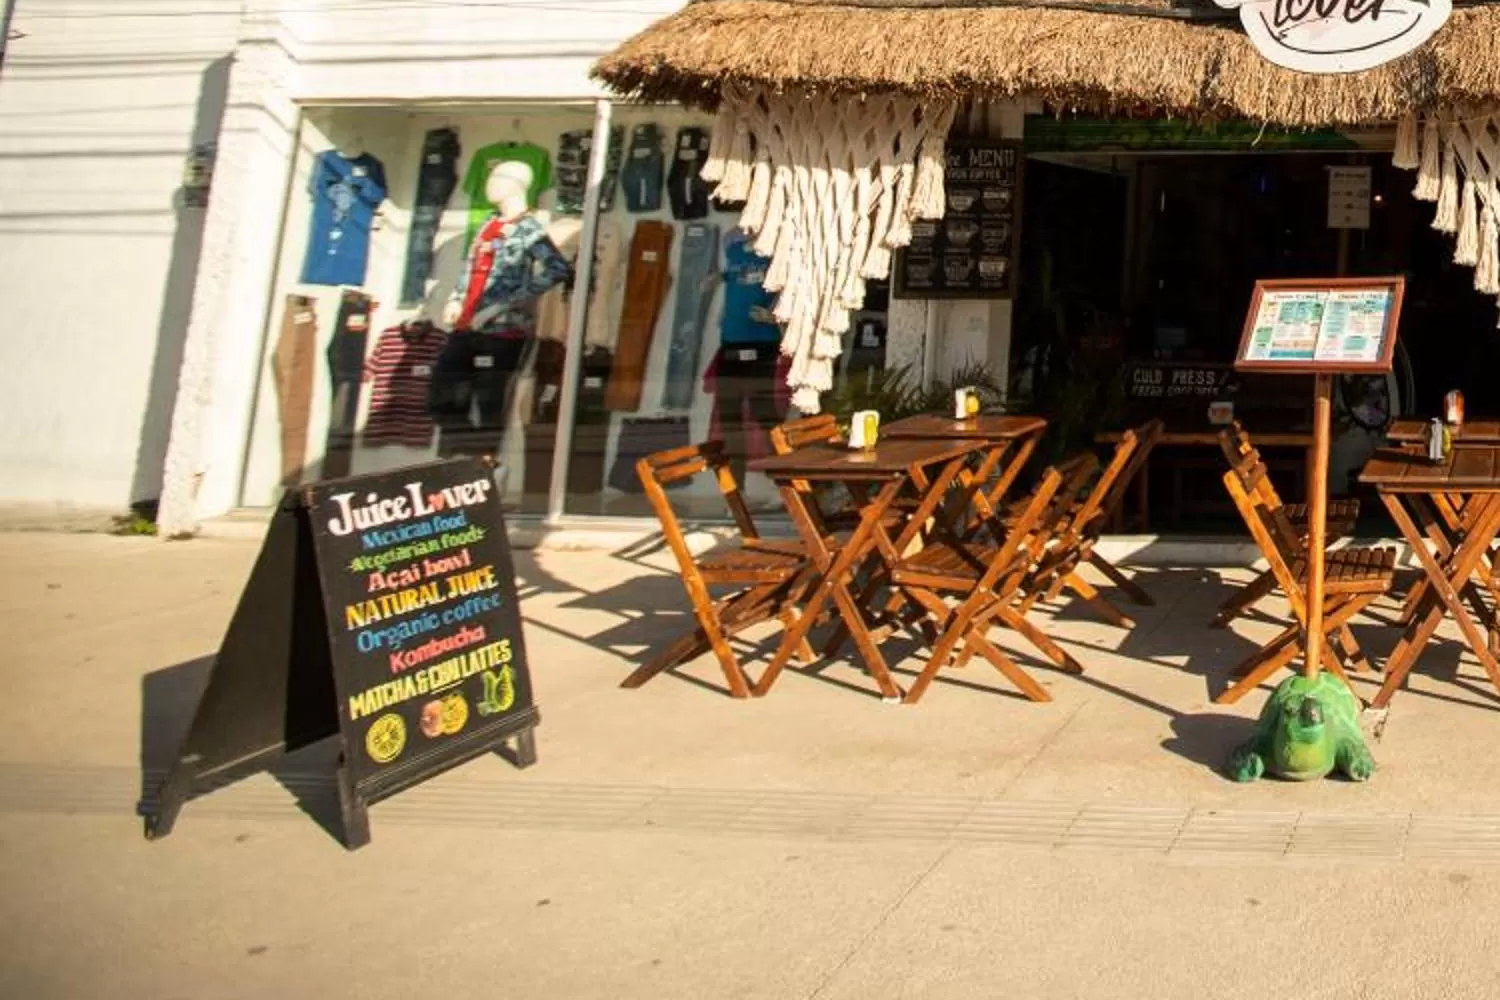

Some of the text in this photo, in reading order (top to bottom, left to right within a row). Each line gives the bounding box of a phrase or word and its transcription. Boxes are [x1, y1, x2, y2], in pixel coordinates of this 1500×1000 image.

[968, 147, 1015, 168] MENU
[1172, 368, 1216, 386] PRESS
[327, 491, 412, 537] Juice
[361, 509, 469, 549] Mexican food
[350, 539, 441, 573] Vegetarian
[422, 548, 472, 578] bowl
[345, 564, 499, 631] NATURAL JUICE
[357, 592, 503, 653] Organic coffee
[388, 625, 487, 674] Kombucha
[349, 675, 417, 721] MATCHA
[459, 637, 513, 679] LATTES
